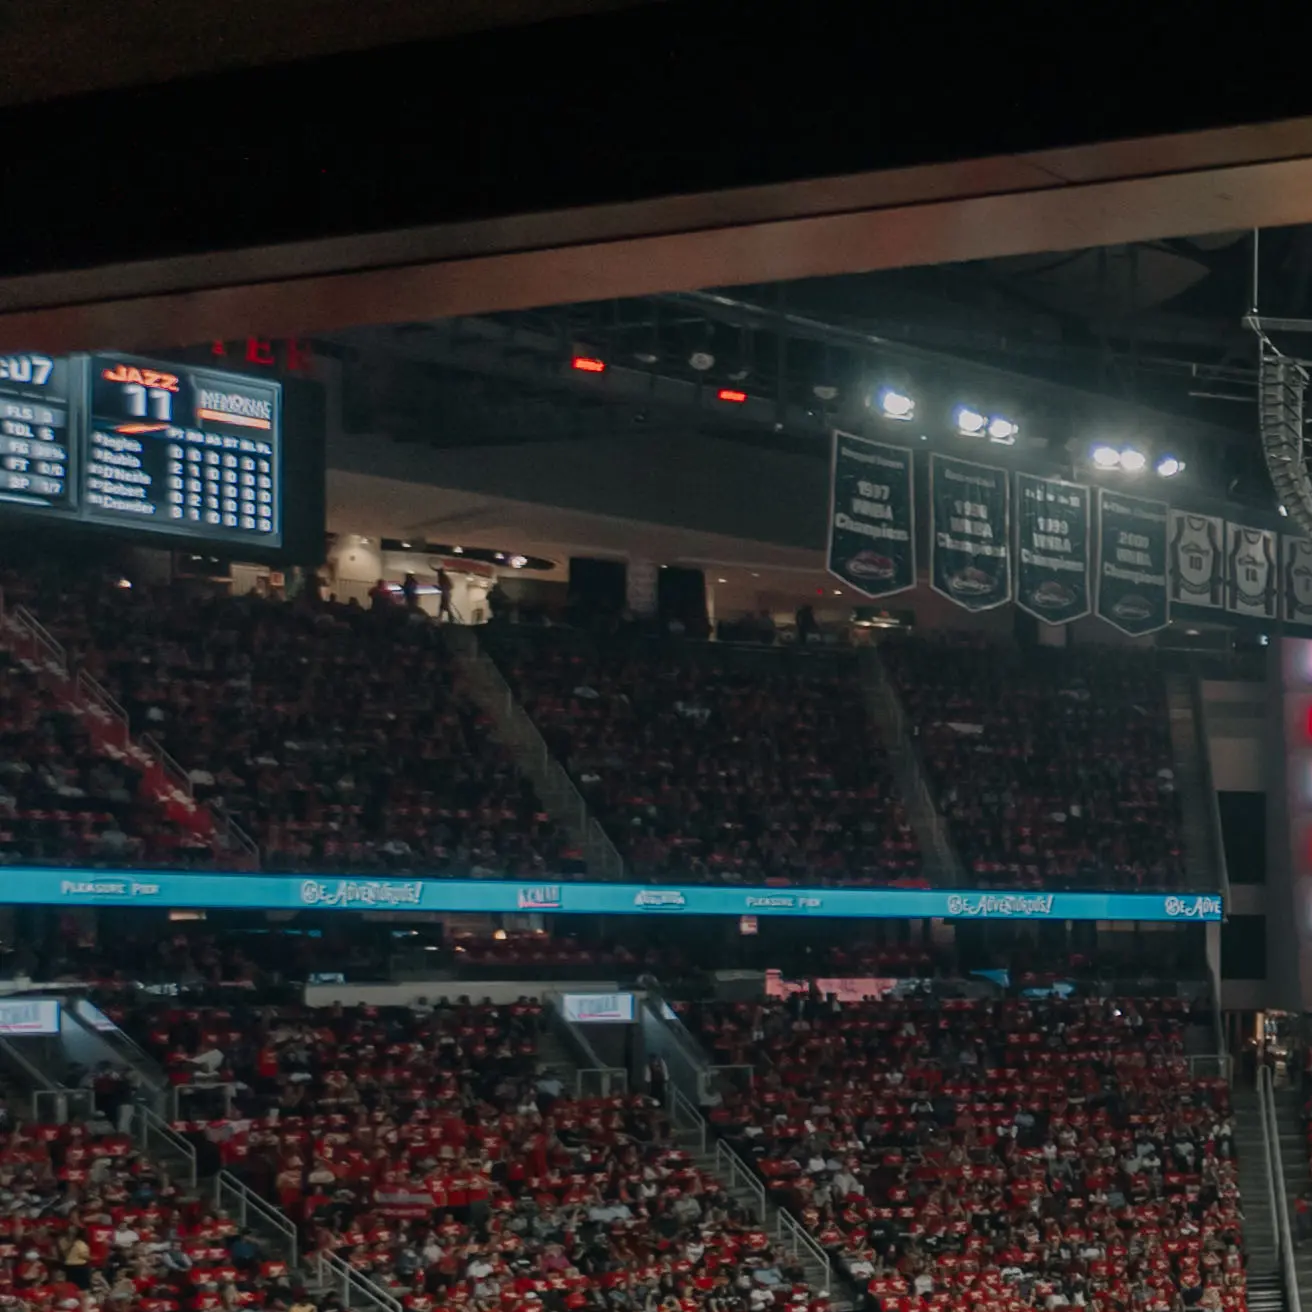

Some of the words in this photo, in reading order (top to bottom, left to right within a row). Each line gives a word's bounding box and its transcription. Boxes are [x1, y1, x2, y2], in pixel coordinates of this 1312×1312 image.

[102, 364, 180, 392] JAZZ
[124, 384, 172, 421] 11
[61, 880, 125, 895] PLEASURE
[132, 882, 160, 895] PIER
